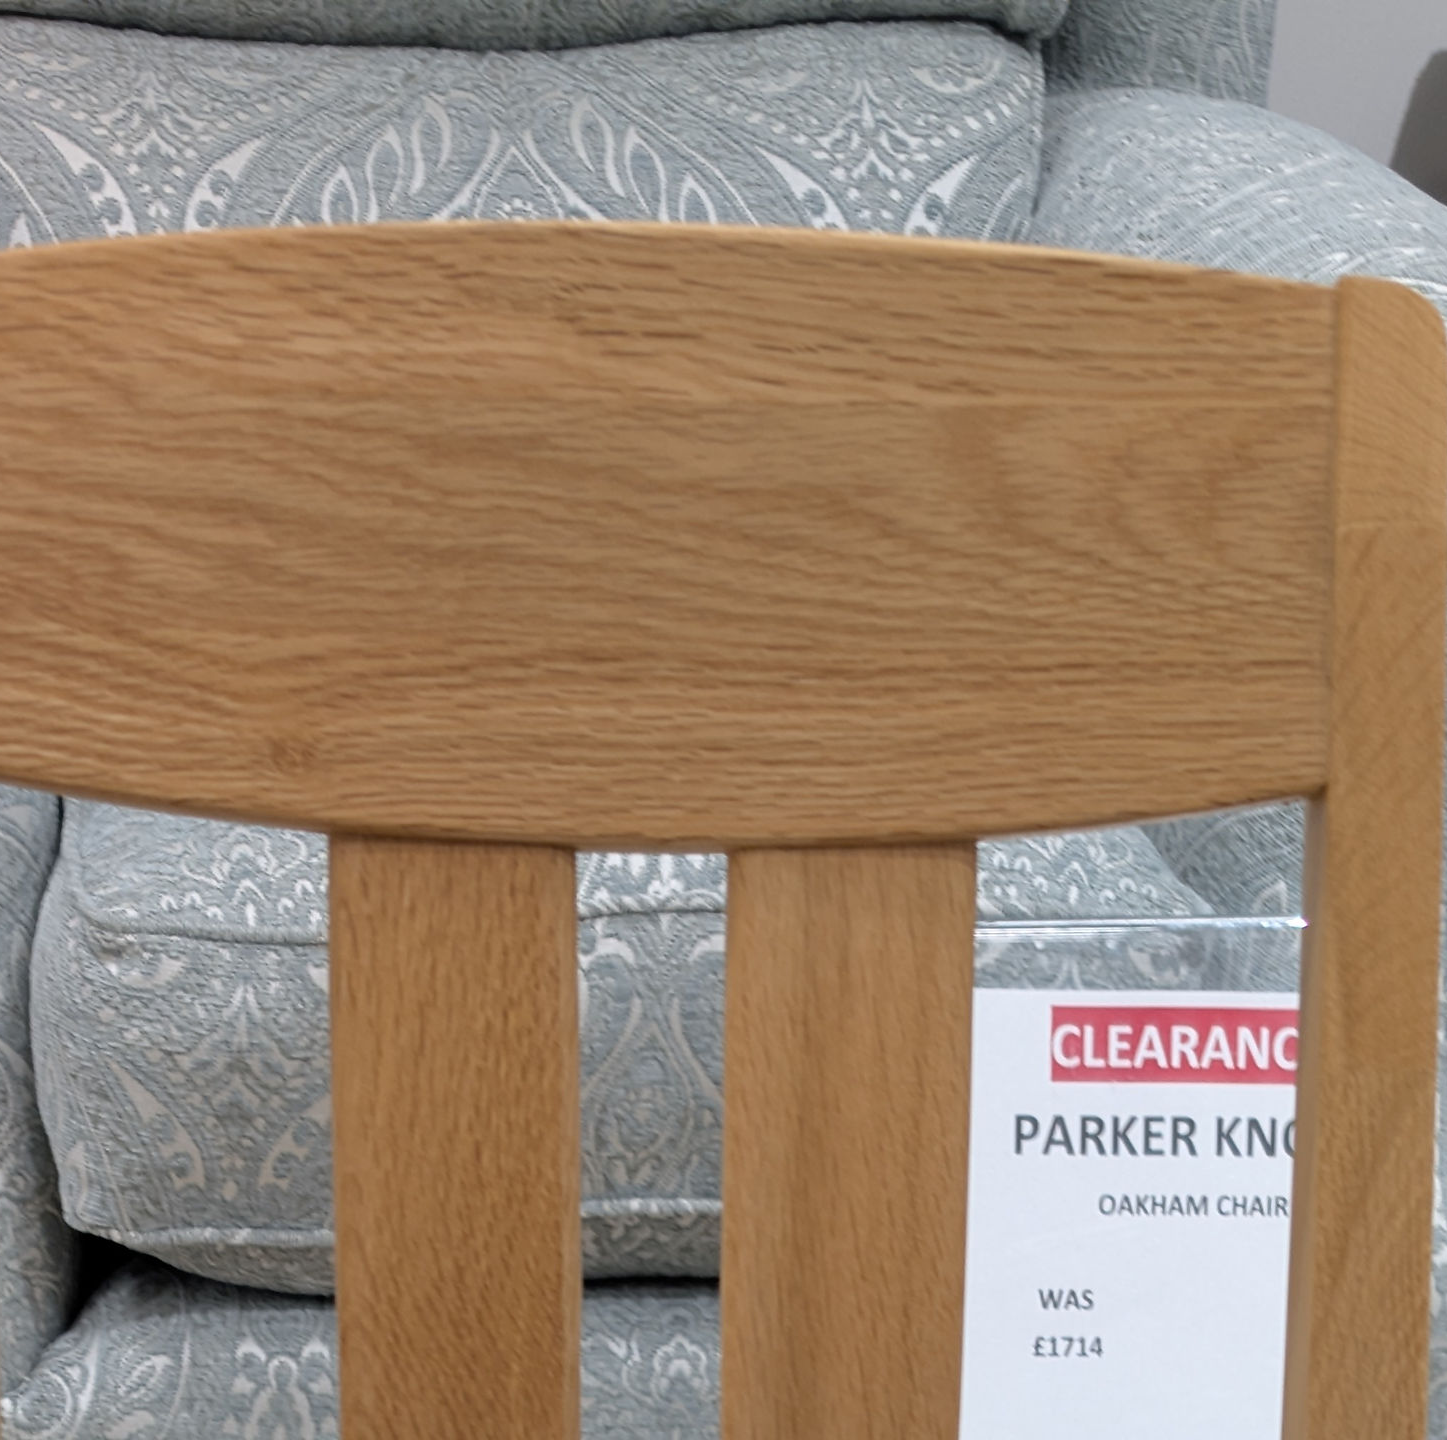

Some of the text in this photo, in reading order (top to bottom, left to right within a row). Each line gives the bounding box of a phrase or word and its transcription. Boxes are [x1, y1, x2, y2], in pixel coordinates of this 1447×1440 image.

[1014, 1114, 1198, 1156] PARKER
[1098, 1194, 1290, 1217] OAKHAM CHAIR
[1038, 1289, 1095, 1310] WAS
[1033, 1336, 1104, 1358] £1714
